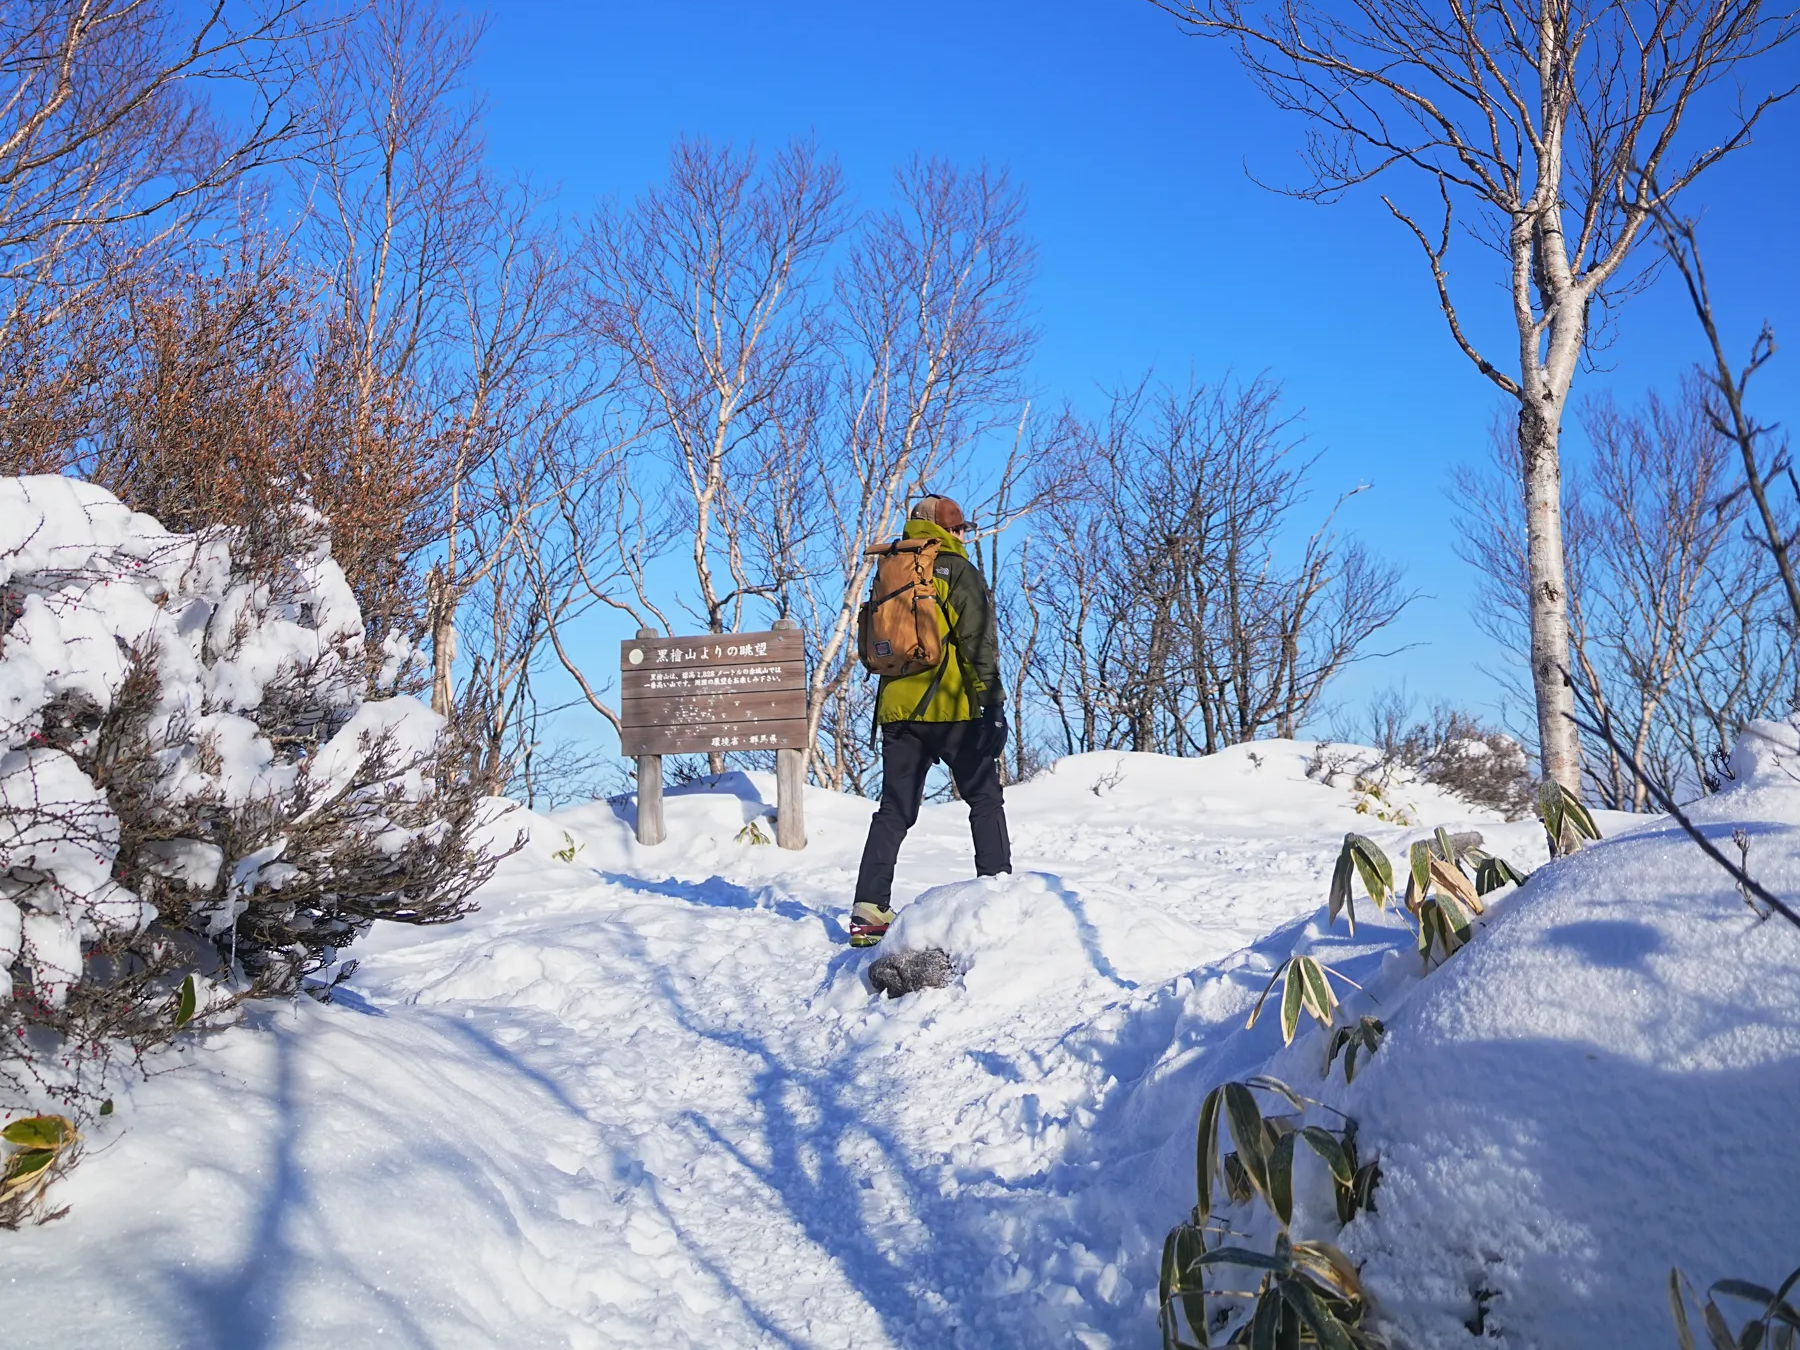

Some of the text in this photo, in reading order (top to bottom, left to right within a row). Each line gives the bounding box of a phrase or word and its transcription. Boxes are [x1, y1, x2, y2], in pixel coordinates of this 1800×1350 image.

[656, 642, 768, 663] 黒檜山よりの眺望
